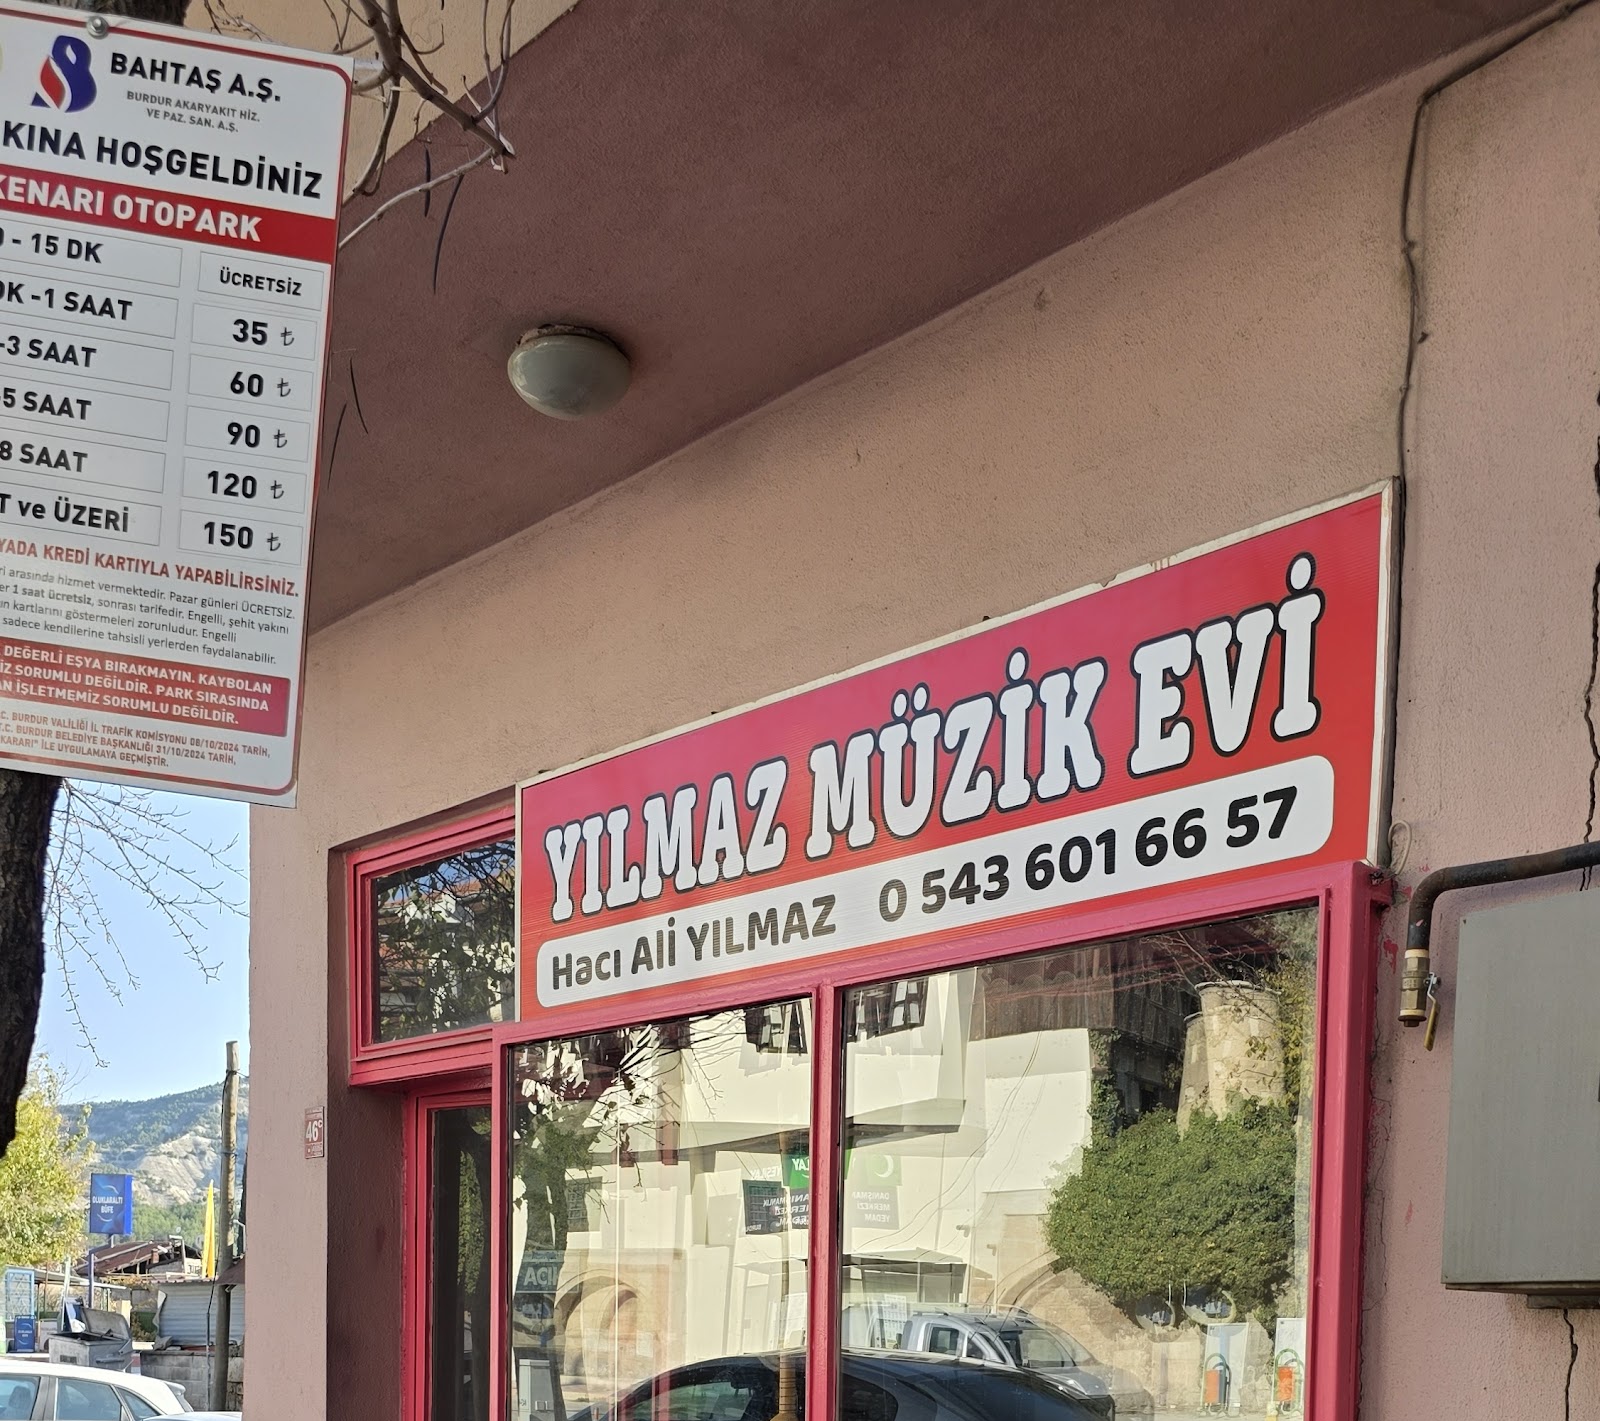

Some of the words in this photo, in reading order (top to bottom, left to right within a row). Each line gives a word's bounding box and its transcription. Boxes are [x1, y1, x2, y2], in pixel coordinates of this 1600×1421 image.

[110, 52, 222, 94] BAHTAŞ
[228, 73, 281, 103] A.Ş.
[127, 90, 172, 108] BURDUR
[174, 99, 237, 118] AKARYAKIT
[240, 109, 260, 123] HİZ.
[147, 108, 160, 119] VE
[163, 111, 186, 124] PAZ.
[189, 116, 214, 128] SAN.
[218, 121, 238, 133] A.Ş.
[3, 120, 85, 160] KINA
[96, 136, 322, 199] HOŞGELDİNİZ
[113, 194, 263, 242] OTOPARK
[31, 233, 59, 256] 15
[66, 239, 104, 264] DK
[220, 266, 302, 297] ÜCRETSİZ
[63, 291, 132, 321] SAAT
[232, 318, 268, 346] 35
[27, 338, 97, 368] SAAT
[230, 371, 264, 397] 60
[23, 391, 92, 420] SAAT
[227, 422, 261, 449] 90
[0, 440, 13, 461] 8
[19, 443, 88, 473] SAAT
[207, 470, 257, 500] 120
[18, 500, 46, 519] ve
[54, 496, 129, 533] ÜZERİ
[203, 521, 254, 549] 150
[43, 544, 90, 566] KREDİ
[94, 552, 169, 578] KARTIYLA
[175, 564, 299, 597] YAPABİLİRSİNİZ.
[9, 568, 54, 583] arasında
[58, 575, 95, 590] hizmet
[98, 582, 166, 600] vermektedir.
[169, 591, 198, 605] Pazar
[200, 597, 238, 611] günleri
[241, 600, 295, 619] ÜCRETSİZ.
[12, 584, 19, 595] 1
[22, 587, 45, 598] saat
[48, 589, 94, 607] ücretsiz,
[97, 599, 136, 612] sonrası
[139, 603, 184, 619] tarifedir.
[188, 610, 225, 627] Engelli,
[229, 617, 255, 630] şehit
[258, 621, 289, 635] yakını
[2, 616, 41, 630] sadece
[44, 620, 105, 639] kendilerine
[107, 632, 145, 646] tahsisli
[148, 637, 199, 654] yerlerden
[202, 644, 276, 665] faydalanabilir.
[13, 600, 63, 617] kartlarını
[65, 609, 135, 628] göstermeleri
[137, 620, 198, 637] zorunludur.
[202, 628, 237, 643] Engelli
[4, 645, 63, 664] DEĞERLİ
[66, 654, 101, 670] EŞYA
[105, 660, 195, 683] BIRAKMAYIN.
[198, 673, 272, 695] KAYBOLAN
[15, 664, 81, 684] SORUMLU
[85, 674, 152, 695] DEĞİLDİR.
[156, 684, 193, 700] PARK
[196, 691, 269, 712] SIRASINDA
[16, 679, 100, 705] İŞLETMEMİZ
[103, 695, 169, 714] SORUMLU
[172, 704, 239, 725] DEĞİLDİR.
[12, 711, 48, 726] BURDUR
[102, 724, 133, 738] TRAFİK
[135, 729, 187, 745] KOMİSYONU
[242, 744, 270, 758] TARİH,
[16, 724, 53, 738] BURDUR
[55, 730, 98, 745] BELEDİYE
[100, 737, 153, 753] BAŞKANLIĞI
[156, 744, 205, 760] 31/10/2024
[208, 752, 236, 765] TARİH,
[41, 738, 55, 751] İLE
[57, 743, 117, 760] UYGULAMAYA
[119, 752, 169, 767] GEÇMİŞTİR.
[544, 757, 788, 924] YILMAZ
[803, 649, 1106, 861] MÜZİK
[1128, 553, 1324, 777] EVİ
[552, 949, 621, 990] Hacı
[686, 894, 837, 962] YILMAZ
[921, 854, 1010, 914] 543
[1025, 828, 1116, 891] 601
[1135, 808, 1207, 867] 66
[1226, 785, 1298, 848] 57
